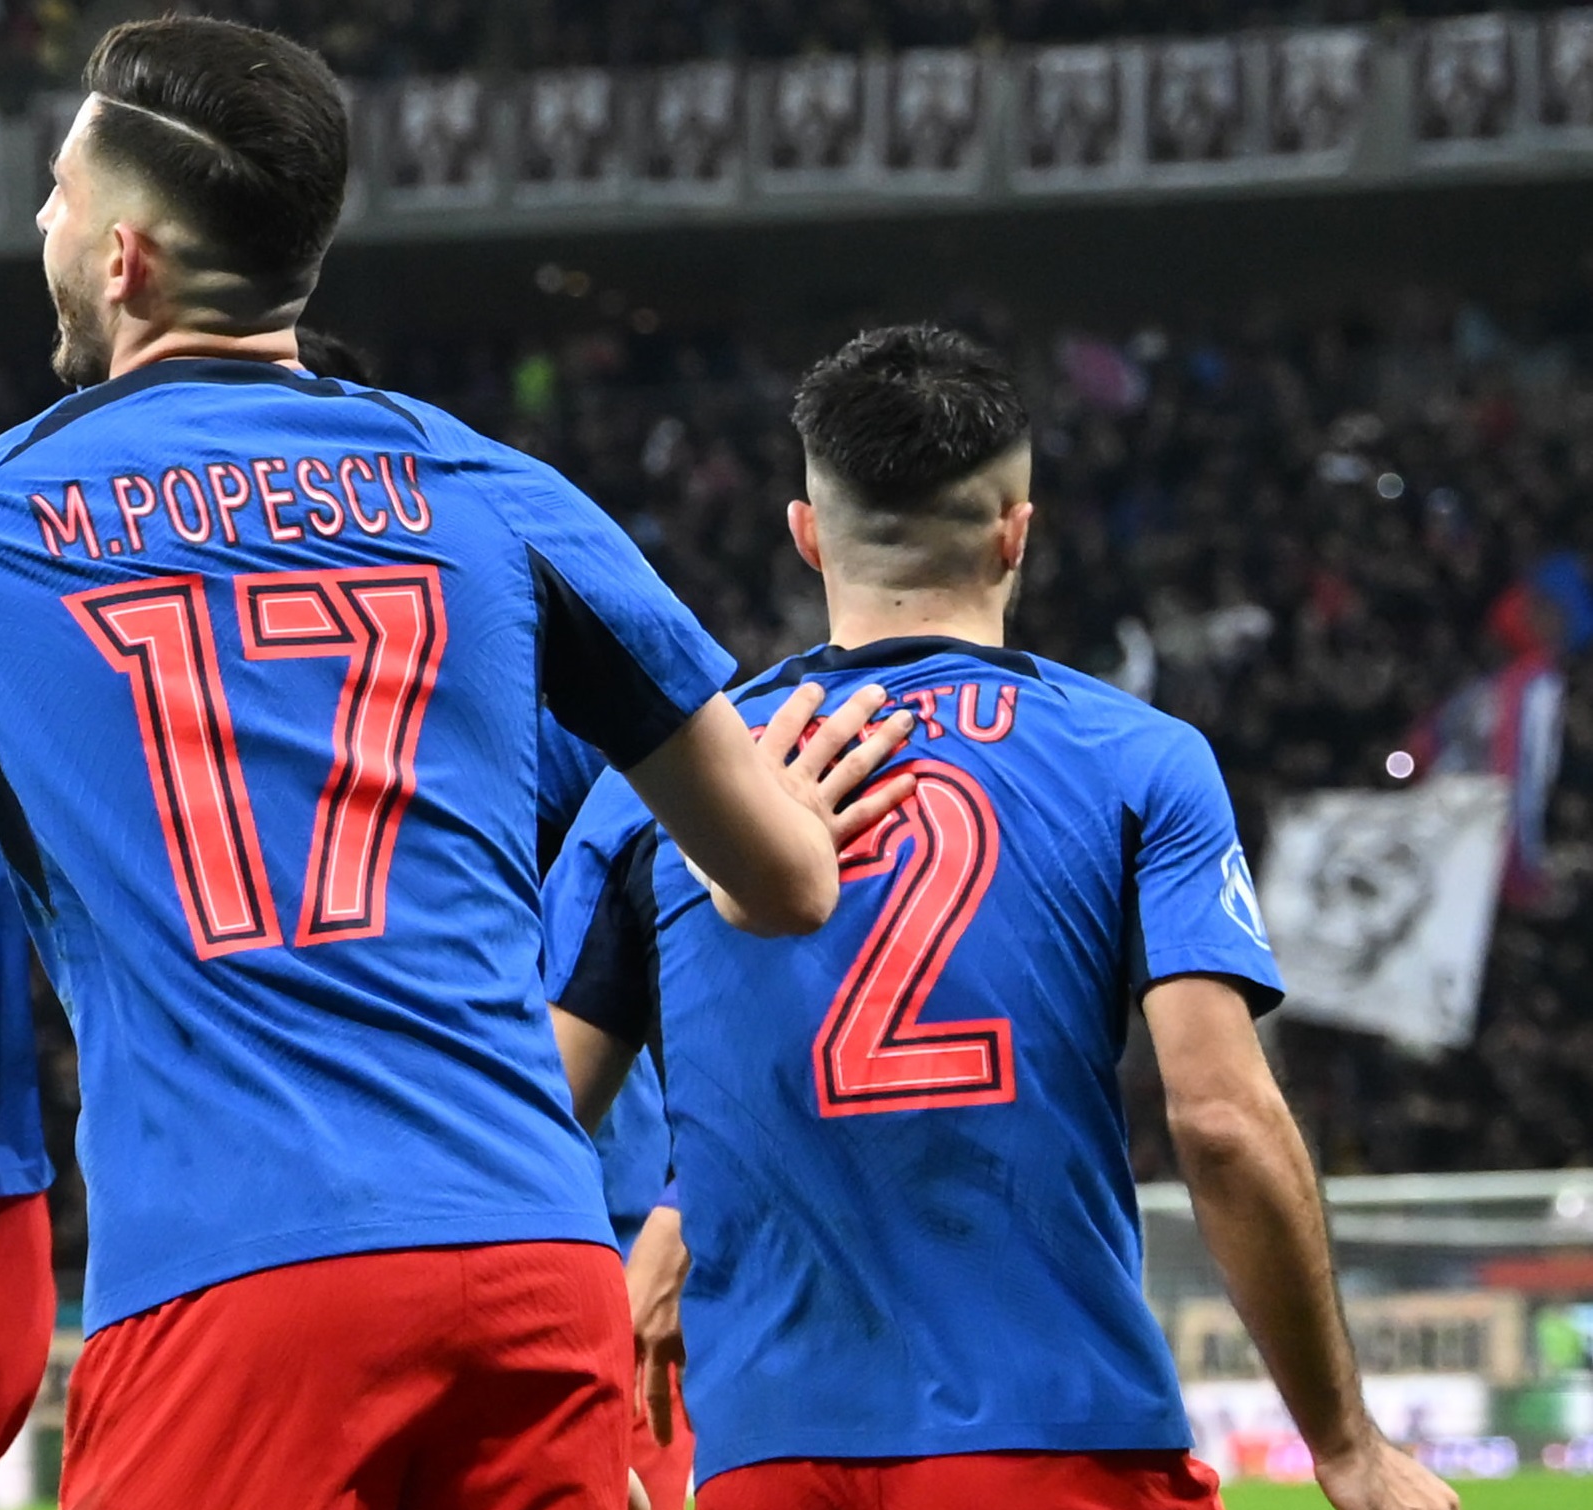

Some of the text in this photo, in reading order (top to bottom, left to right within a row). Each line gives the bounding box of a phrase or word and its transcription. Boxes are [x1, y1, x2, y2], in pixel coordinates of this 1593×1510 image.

[28, 452, 433, 559] M.POPESCU
[61, 564, 447, 961] 17
[812, 759, 1016, 1118] 2
